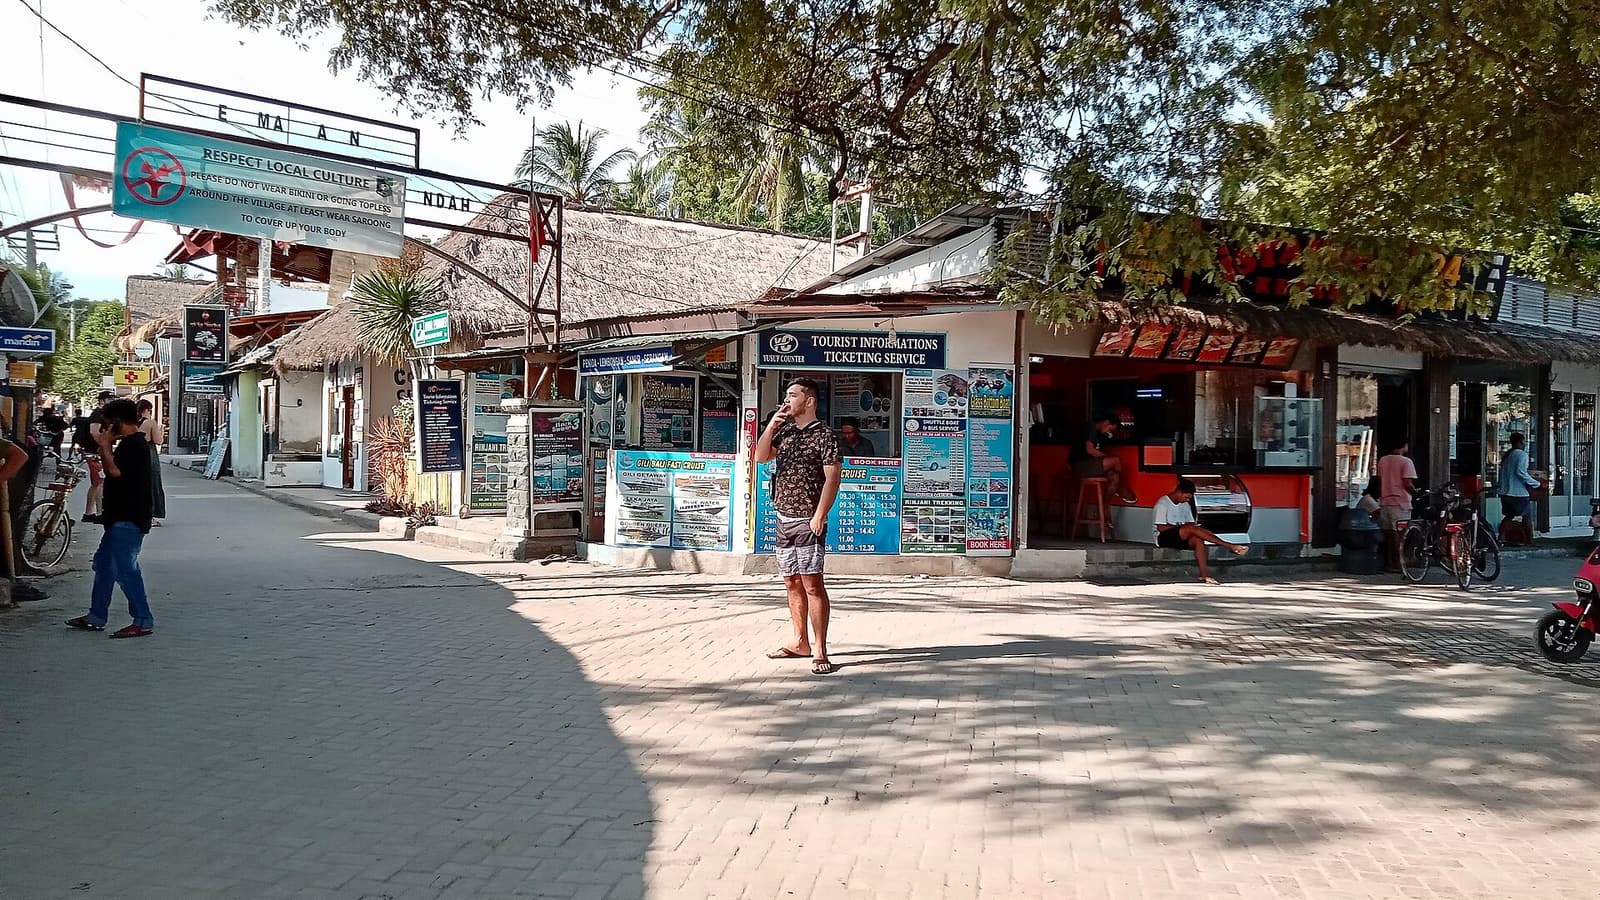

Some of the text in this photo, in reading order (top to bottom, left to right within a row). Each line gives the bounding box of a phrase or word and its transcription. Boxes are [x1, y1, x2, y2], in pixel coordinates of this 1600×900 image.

[203, 148, 370, 189] RESPECT LOCAL CULTURE
[190, 171, 392, 214] PLEASE DO NOT WEAR BIKINI OR GOING TOPLESS
[189, 188, 392, 229] AROUND THE VILLAGE AT LEAST WEAR SAROONG
[241, 214, 347, 238] TO COVER UP YOUR BODY
[811, 335, 858, 348] TOURIST
[823, 351, 926, 365] TICKETING SERVICE
[636, 459, 650, 468] GILI
[651, 459, 666, 468] BALI
[666, 460, 681, 469] FAST
[682, 461, 706, 470] CRUISE
[840, 469, 867, 479] CRUISE
[989, 541, 1007, 549] HERE
